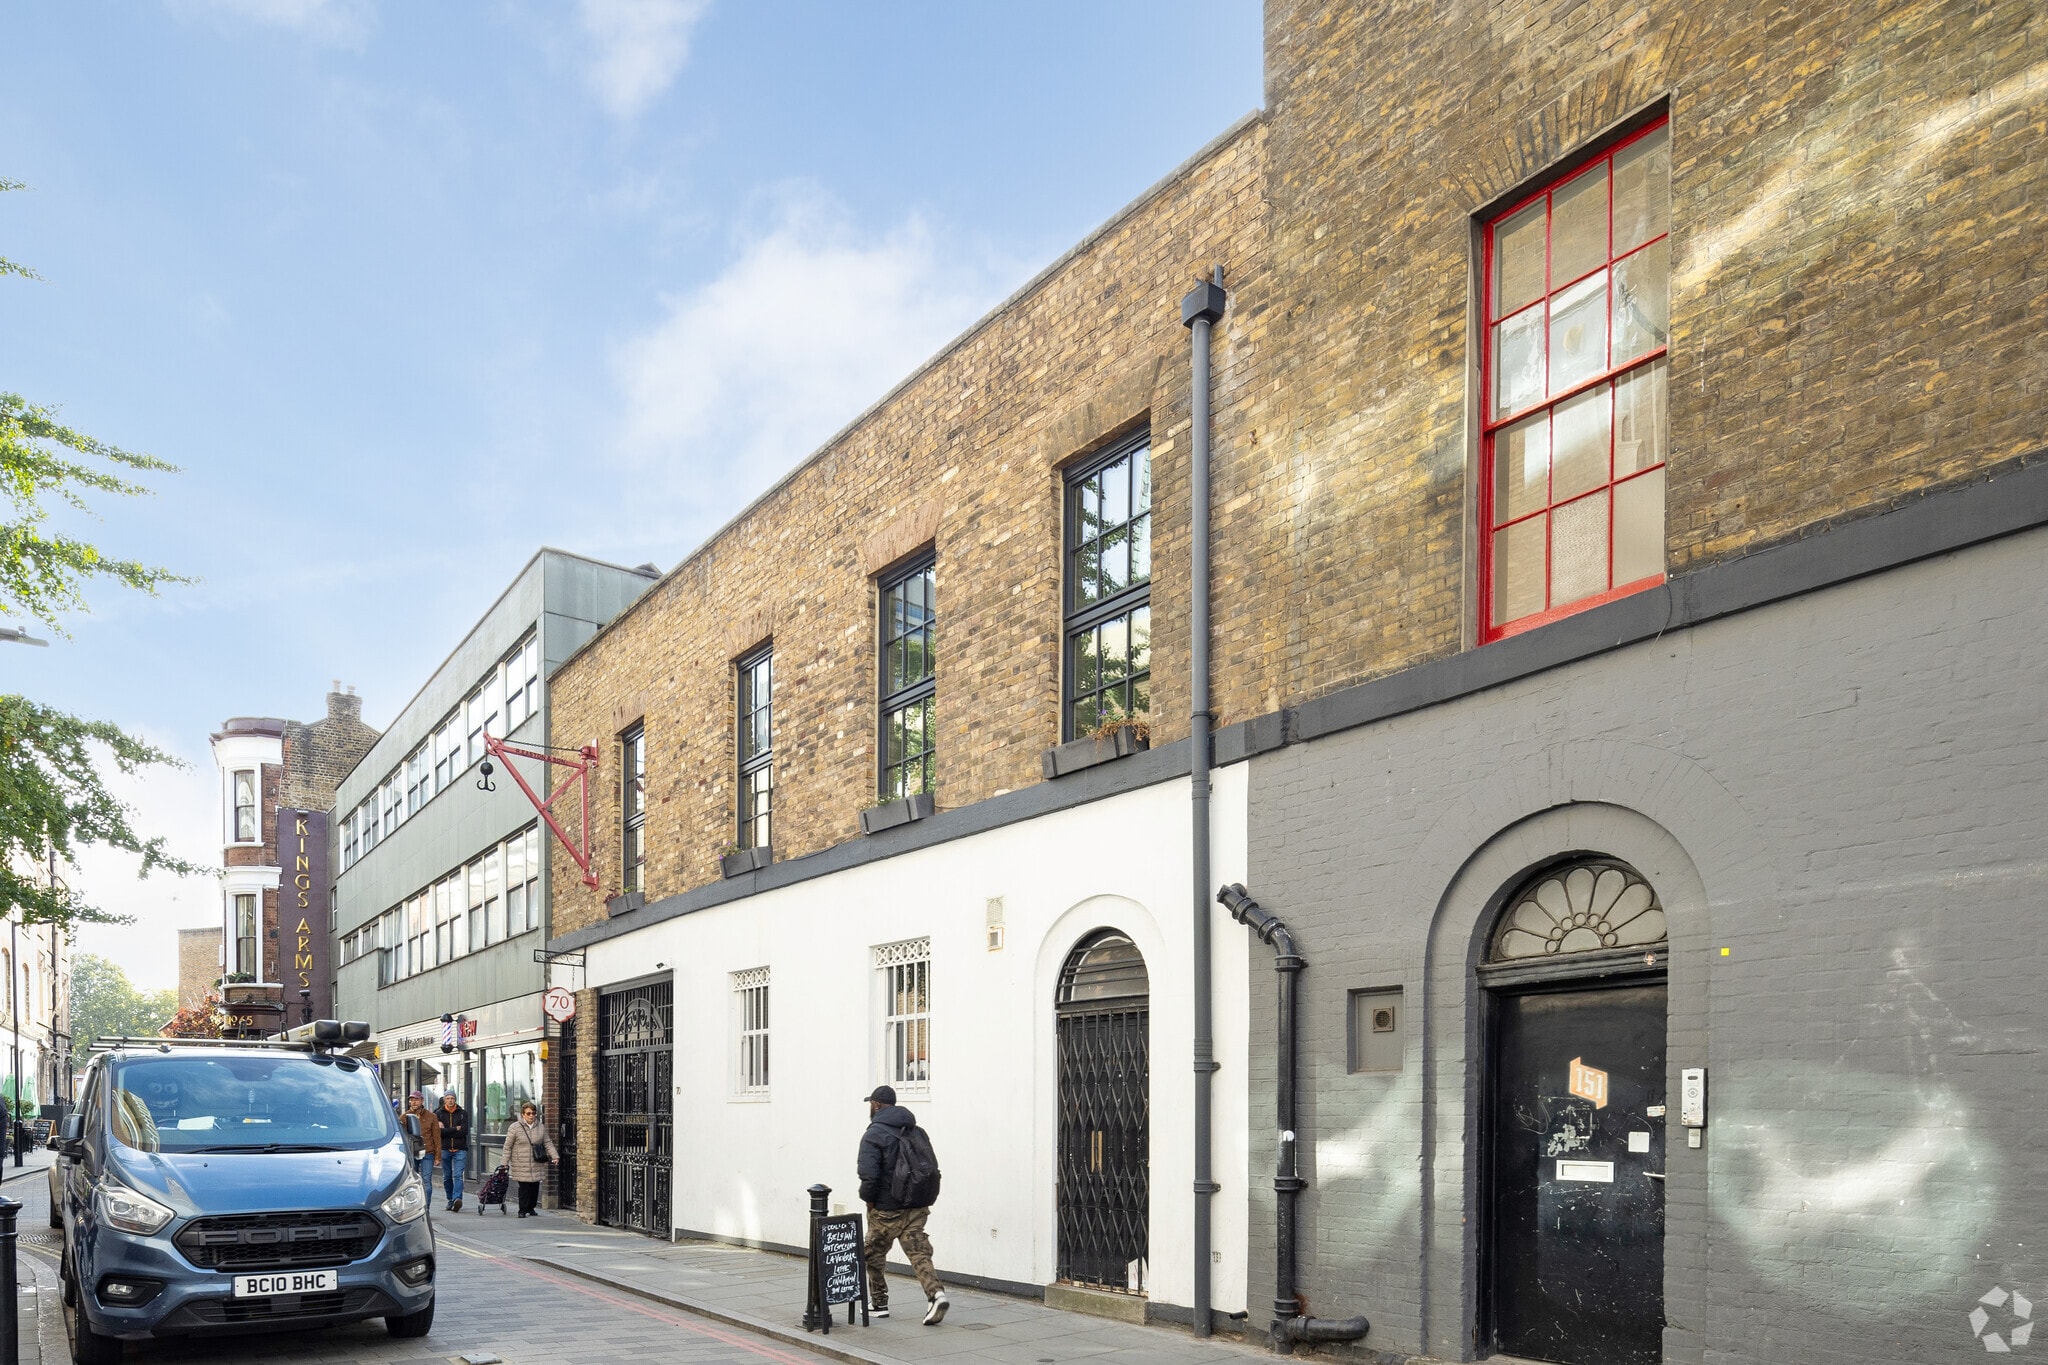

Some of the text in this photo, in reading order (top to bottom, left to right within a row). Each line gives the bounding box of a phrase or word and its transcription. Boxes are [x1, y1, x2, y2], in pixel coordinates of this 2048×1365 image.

[294, 819, 313, 988] KINGS ARMS
[550, 995, 569, 1009] 70
[1576, 1067, 1602, 1099] 151
[199, 1224, 363, 1246] FORD
[247, 1274, 326, 1293] BC10 BHC
